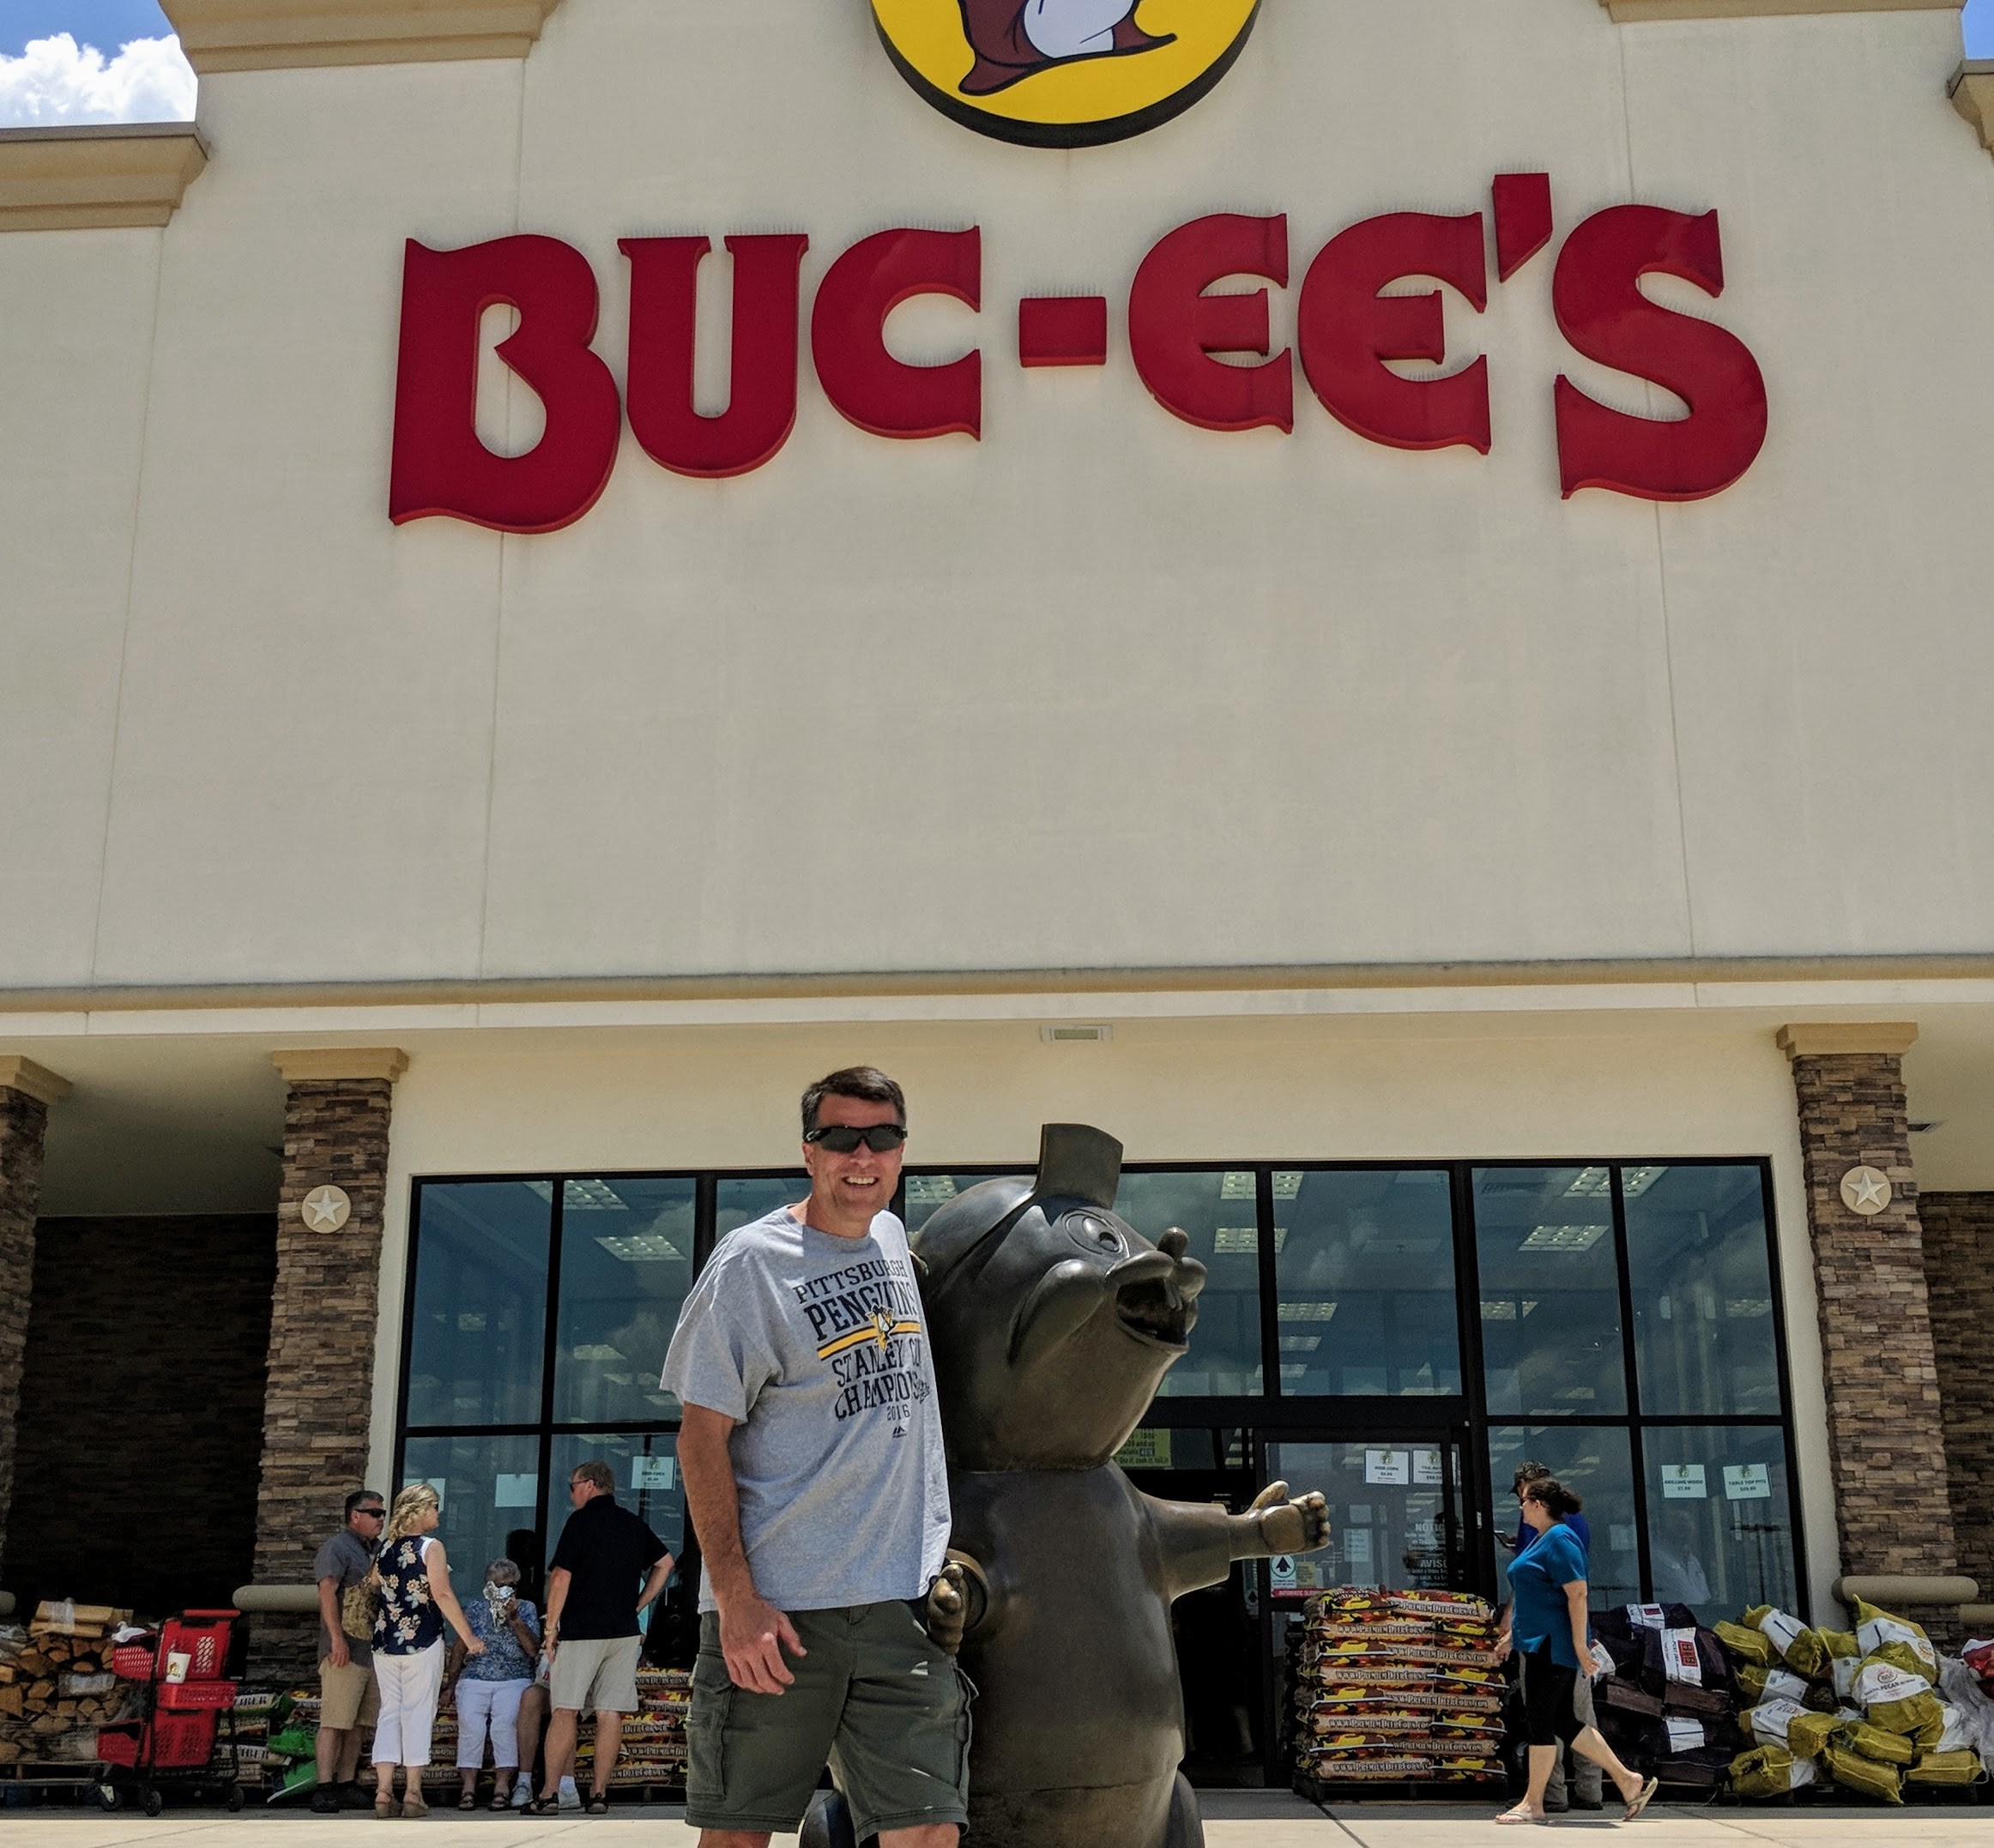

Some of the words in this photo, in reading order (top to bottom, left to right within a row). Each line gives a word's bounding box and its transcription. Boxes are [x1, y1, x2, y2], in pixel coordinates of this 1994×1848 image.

[390, 172, 1768, 534] BUC-EE'S
[793, 1259, 909, 1305] PITTSBURGH
[831, 1337, 904, 1388] STANLEY
[886, 1404, 910, 1421] 2016
[1415, 1522, 1446, 1532] NOTIC
